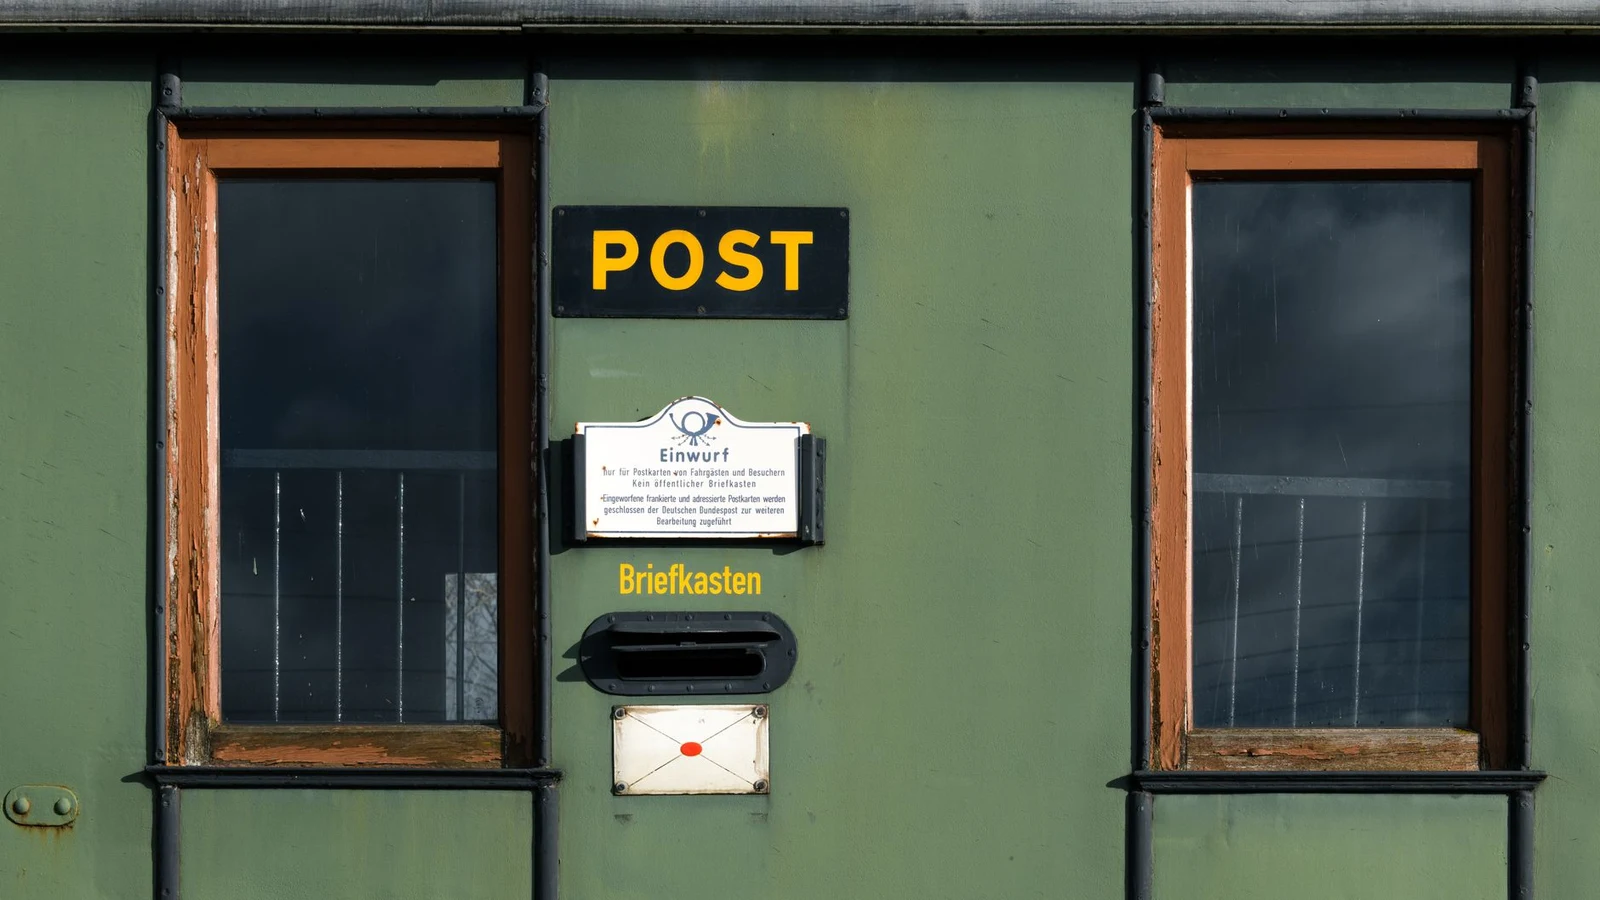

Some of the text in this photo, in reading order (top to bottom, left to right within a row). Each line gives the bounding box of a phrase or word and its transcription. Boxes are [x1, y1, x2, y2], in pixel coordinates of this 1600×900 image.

[593, 229, 814, 292] POST
[660, 447, 729, 463] Einwurf
[619, 468, 629, 476] für
[633, 468, 671, 476] Postkarten
[690, 468, 729, 478] Fahrgästen
[732, 468, 745, 476] und
[748, 468, 785, 476] Besuchern
[632, 479, 756, 488] Kein öffentlicher Briefkasten
[602, 494, 786, 504] Eingeworfene frankierte und adressierte Postkarten werden
[604, 505, 645, 515] geschlossen
[647, 505, 659, 514] der
[661, 505, 697, 514] Deutschen
[699, 506, 738, 516] Bundespost
[755, 506, 785, 514] weiteren
[656, 517, 732, 527] Bearbeitung zugeführt
[619, 563, 762, 596] Briefkasten
